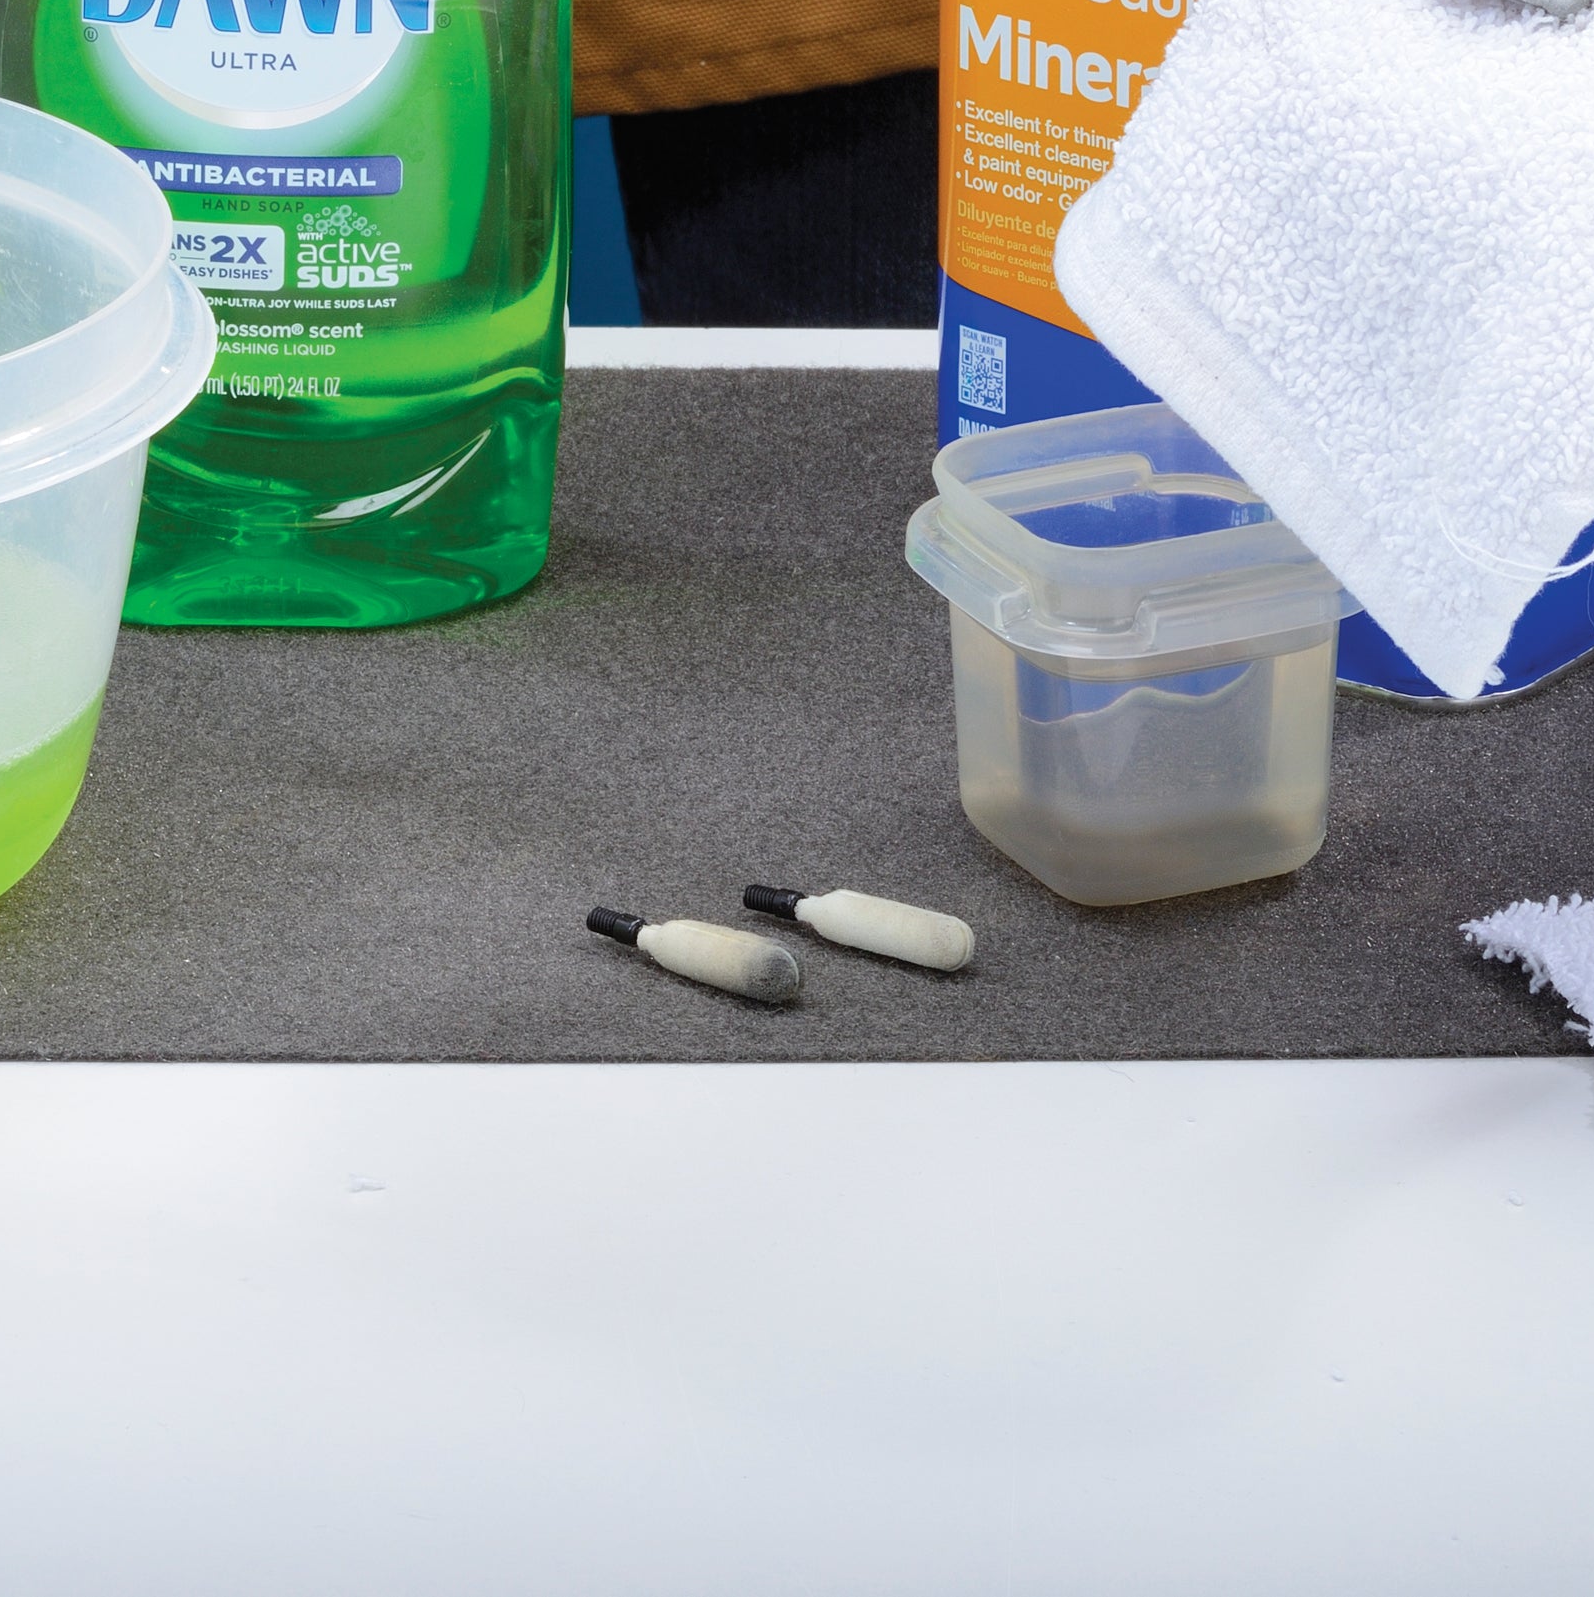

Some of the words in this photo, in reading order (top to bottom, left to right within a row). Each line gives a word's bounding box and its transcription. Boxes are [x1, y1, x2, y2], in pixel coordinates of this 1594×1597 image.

[210, 51, 298, 72] ULTRA
[964, 99, 1041, 135] Excellent
[1044, 119, 1070, 141] for
[1073, 126, 1121, 152] thinn
[964, 123, 1041, 159] Excellent
[1044, 145, 1110, 173] cleaner
[963, 148, 976, 166] &
[979, 154, 1022, 177] paint
[1025, 166, 1095, 193] equipm
[964, 170, 999, 194] Low
[1002, 184, 1043, 205] odor
[202, 198, 251, 212] HAND
[258, 200, 304, 213] SOAP
[956, 199, 1033, 235] Diluyente
[1035, 220, 1056, 240] de
[209, 235, 267, 264] 2X
[297, 232, 323, 241] WITH
[961, 226, 1005, 247] Excelente
[1006, 239, 1028, 254] para
[297, 238, 401, 264] active
[961, 241, 1006, 262] Limpiador
[1007, 251, 1053, 273] excelente
[961, 257, 980, 271] Olor
[982, 262, 1010, 278] suave
[1017, 272, 1048, 288] Bueno
[268, 299, 291, 309] JOY
[293, 300, 332, 309] WHILE
[333, 299, 365, 309] SUDS
[367, 298, 397, 308] LAST
[309, 321, 363, 338] scent
[962, 328, 979, 343] SCAN,
[980, 333, 1003, 348] WATCH
[283, 344, 336, 356] LIQUID
[975, 344, 995, 357] LEARN
[206, 376, 227, 396] mL
[230, 371, 260, 400] (1.50
[263, 373, 285, 401] PT)
[287, 376, 304, 398] 24
[307, 376, 320, 397] FL
[324, 376, 342, 397] OZ
